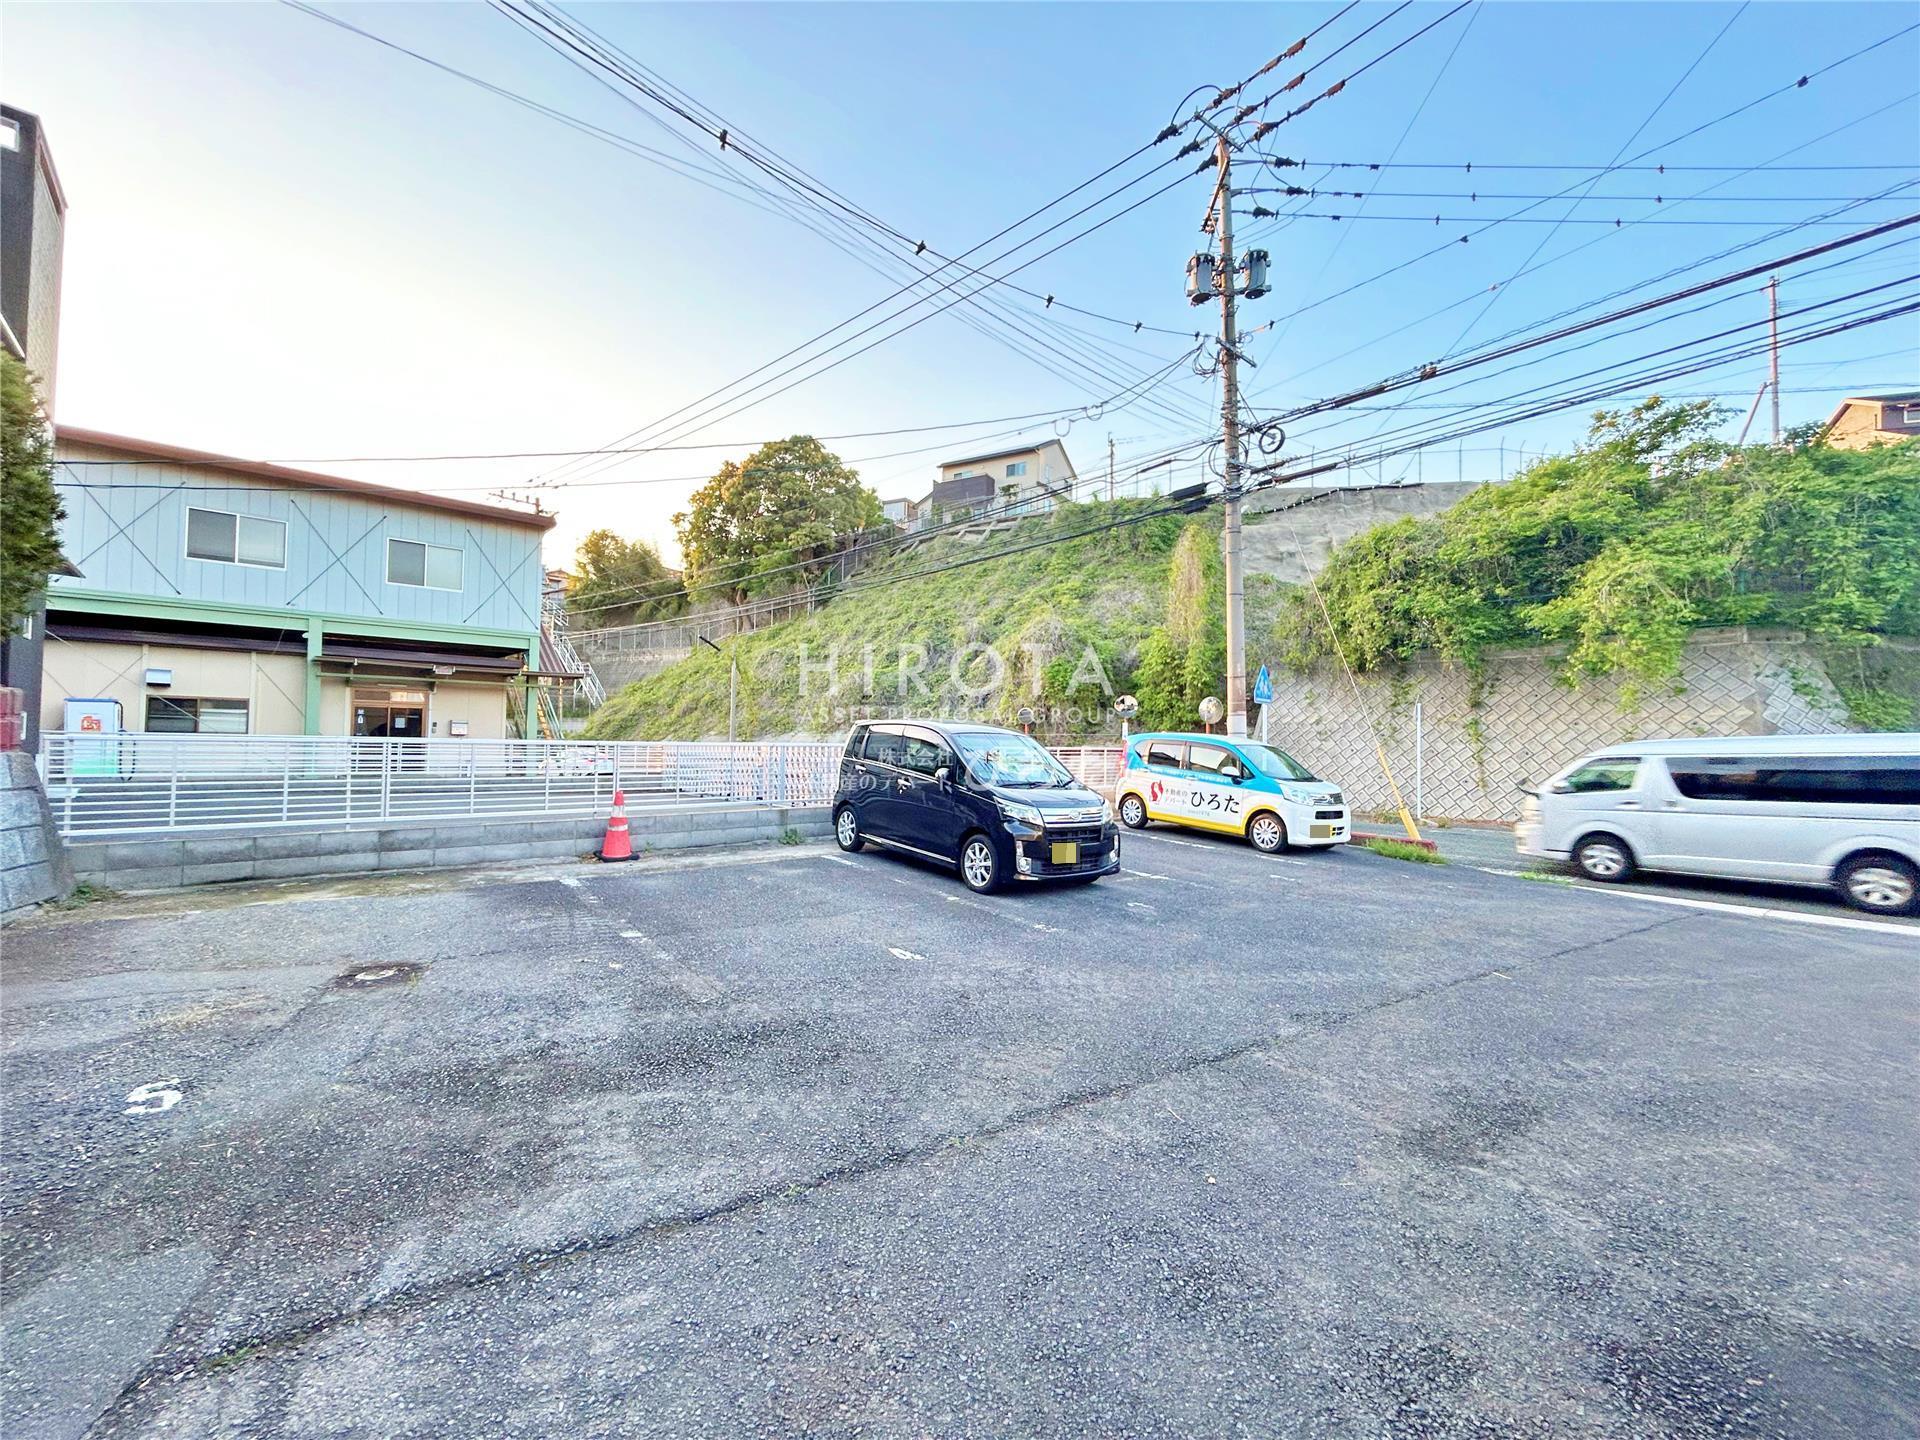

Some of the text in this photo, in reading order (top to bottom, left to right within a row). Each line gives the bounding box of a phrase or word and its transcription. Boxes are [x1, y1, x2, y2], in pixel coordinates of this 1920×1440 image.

[1191, 792, 1240, 813] ひろた
[121, 1078, 183, 1115] 5
